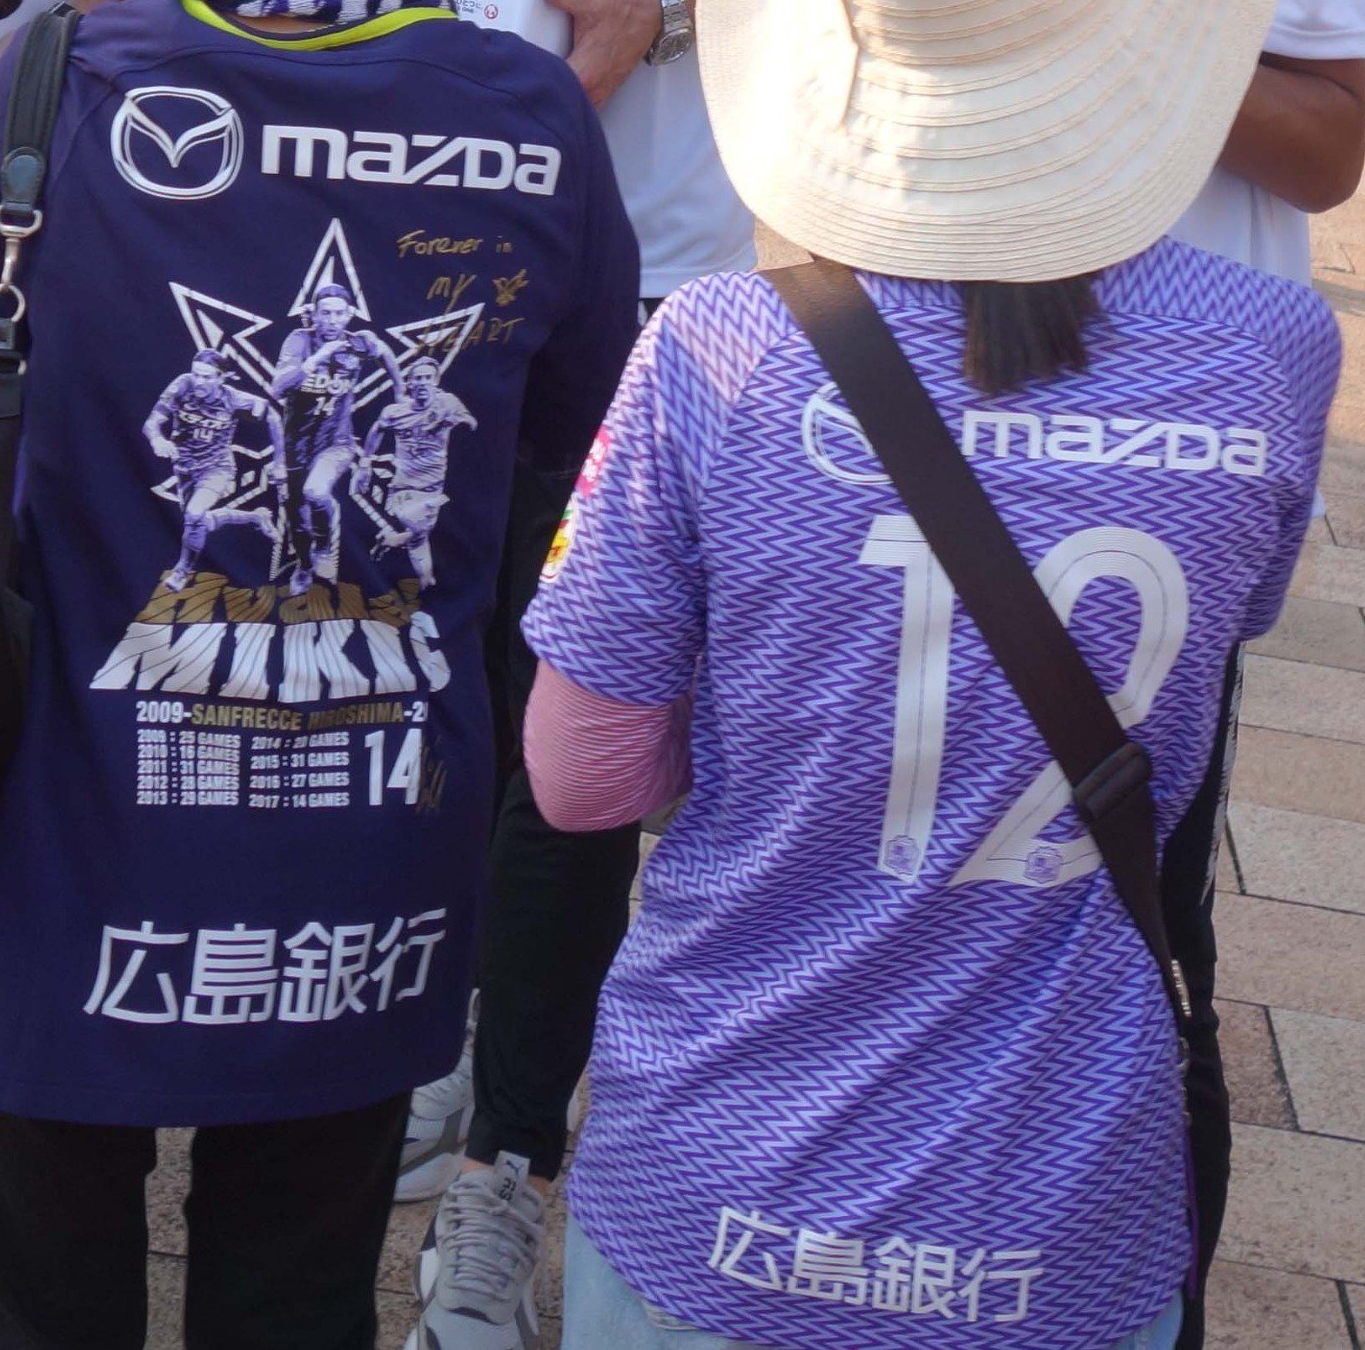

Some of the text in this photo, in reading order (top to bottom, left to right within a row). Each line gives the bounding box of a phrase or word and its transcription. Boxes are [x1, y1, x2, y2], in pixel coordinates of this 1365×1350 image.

[364, 728, 422, 806] 14
[83, 907, 447, 1025] 広島銀行
[708, 1206, 1043, 1323] 広島銀行
